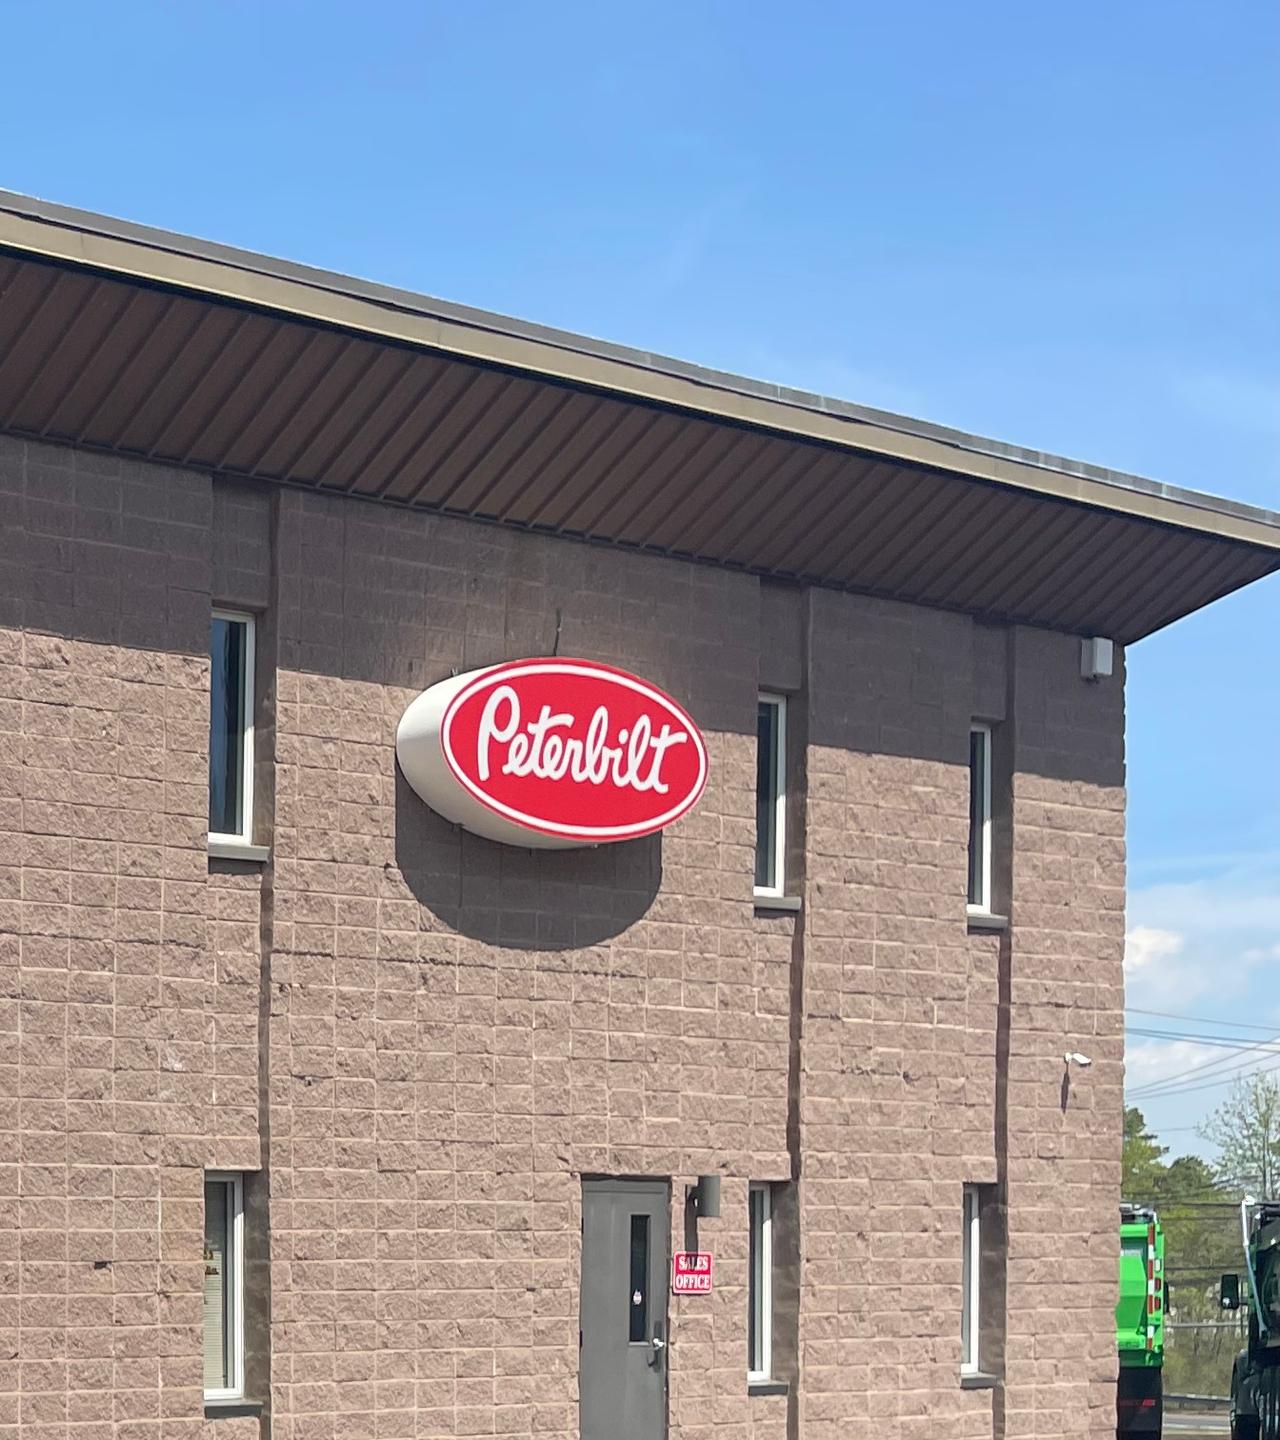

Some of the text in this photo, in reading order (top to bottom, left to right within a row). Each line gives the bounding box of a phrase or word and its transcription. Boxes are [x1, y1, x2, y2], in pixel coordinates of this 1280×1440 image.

[477, 684, 688, 795] Peterbilt
[678, 1255, 708, 1271] SALES
[675, 1274, 711, 1289] OFFICE
